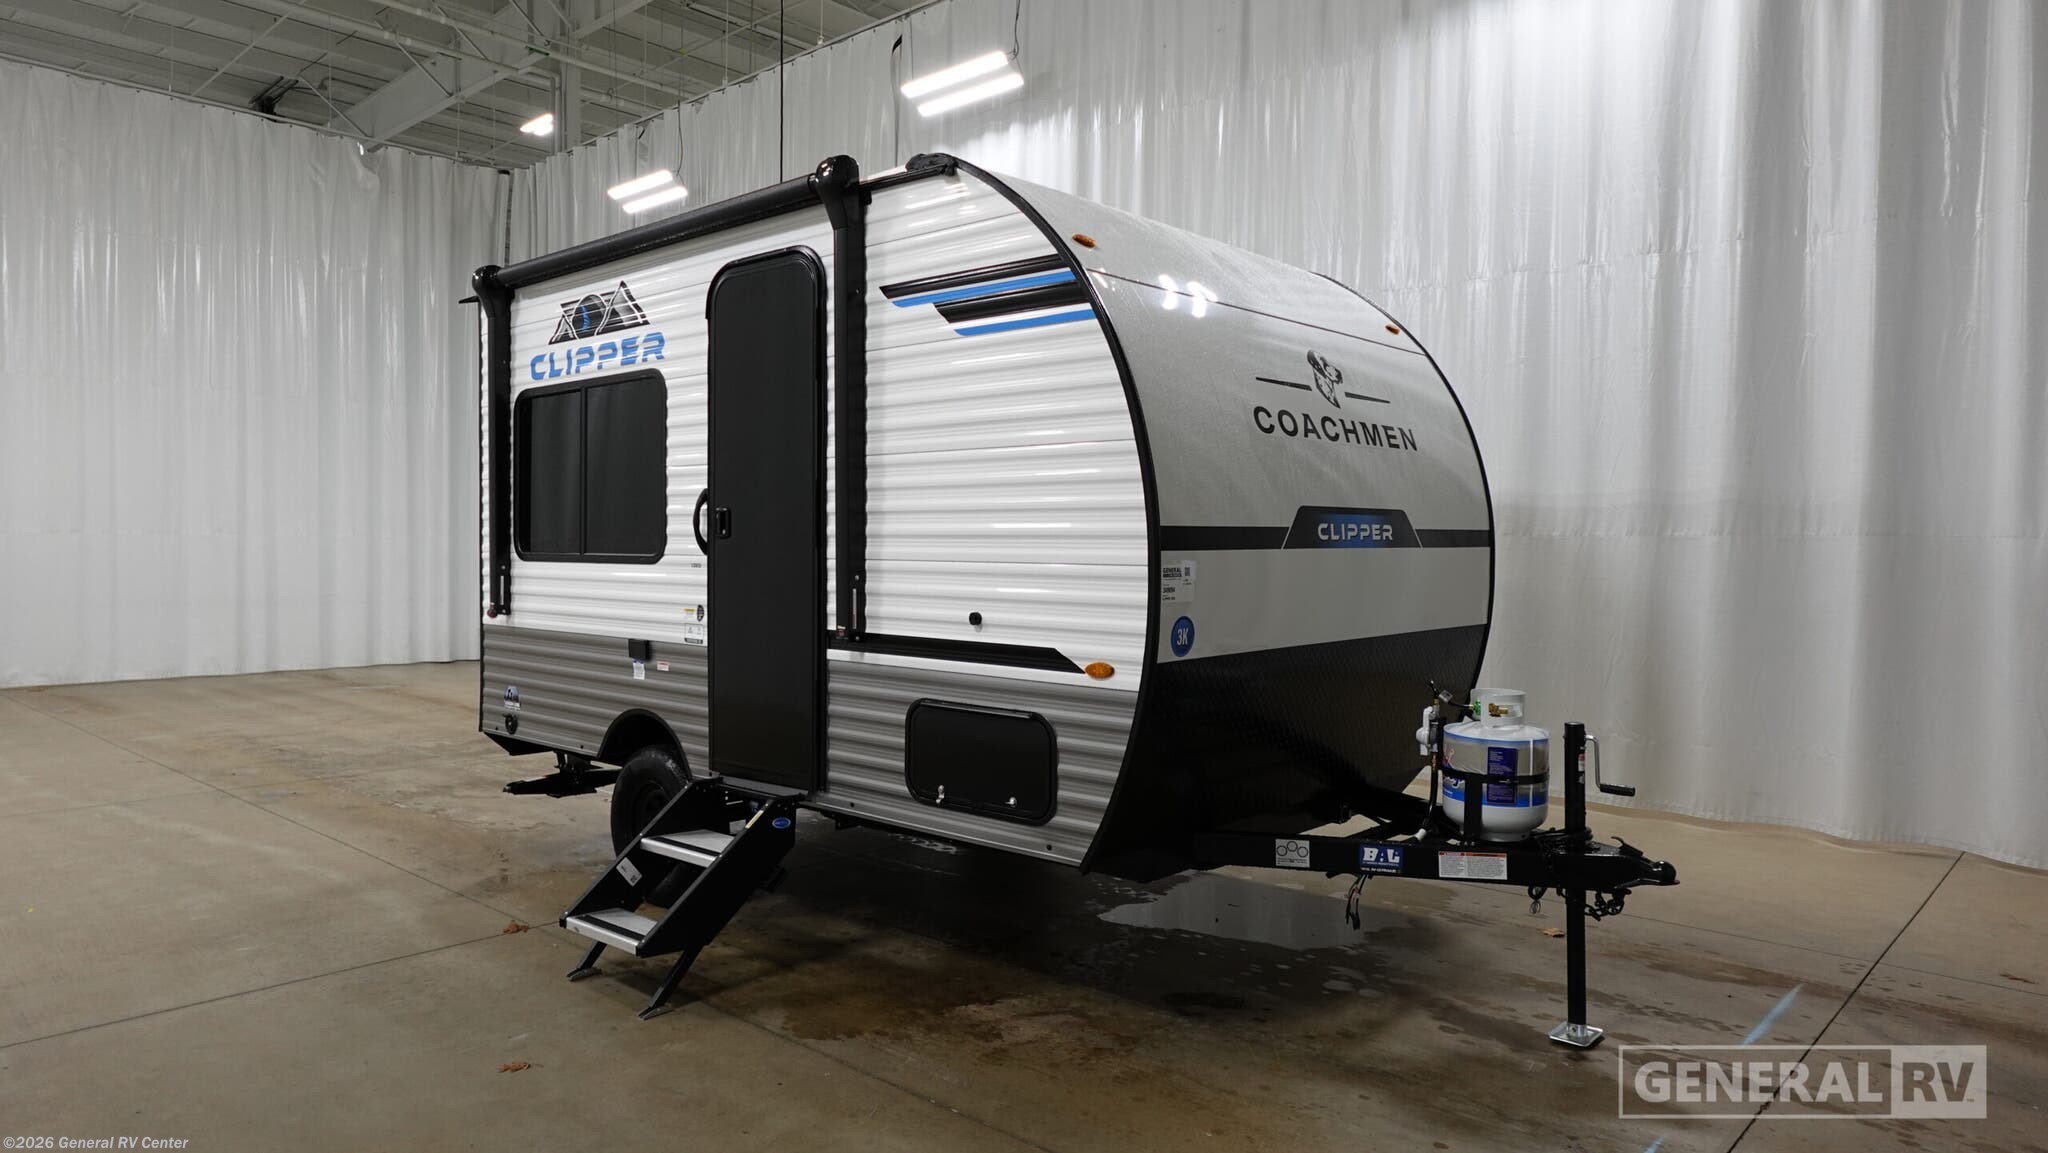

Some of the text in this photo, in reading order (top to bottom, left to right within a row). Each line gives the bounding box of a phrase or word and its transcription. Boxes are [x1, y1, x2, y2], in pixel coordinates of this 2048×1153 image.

[530, 331, 666, 381] CLIPPER
[1253, 406, 1418, 451] COACHMEN
[1317, 523, 1393, 541] CLIPPER
[1176, 628, 1189, 646] 3K
[1362, 847, 1400, 864] BAL
